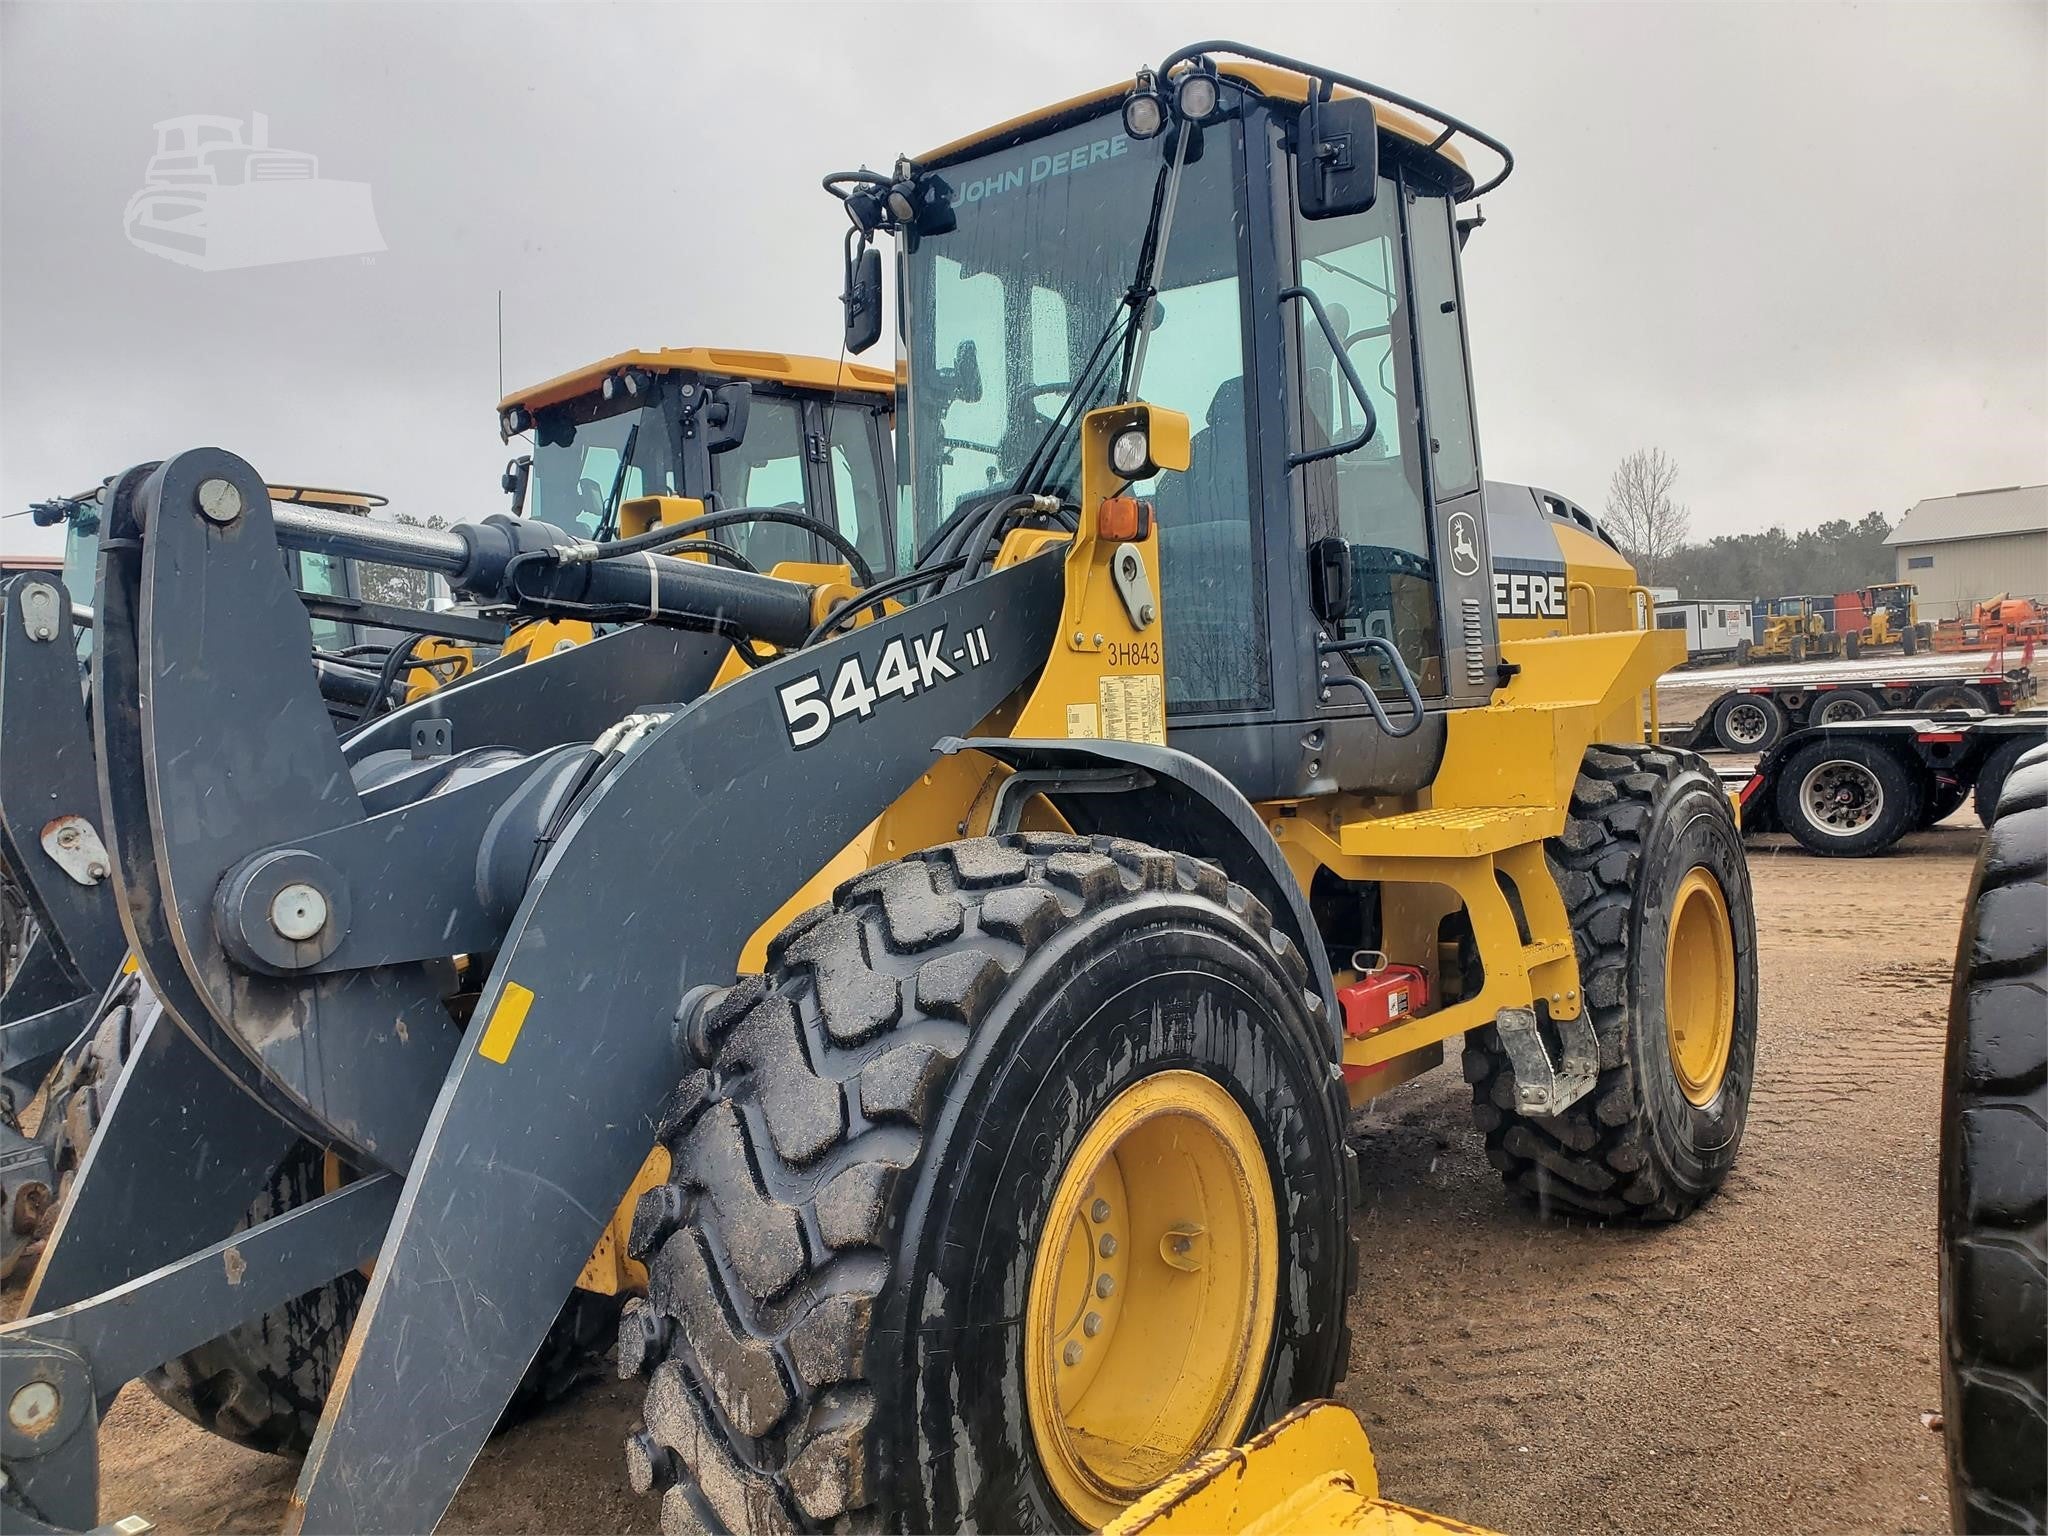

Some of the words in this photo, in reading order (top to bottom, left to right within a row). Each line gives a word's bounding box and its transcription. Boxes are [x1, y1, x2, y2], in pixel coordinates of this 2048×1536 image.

[951, 166, 1025, 208] JOHN
[1030, 134, 1129, 183] DEERE
[1494, 574, 1565, 615] EERE
[1107, 641, 1160, 666] 3H843
[780, 627, 990, 746] 544K-II
